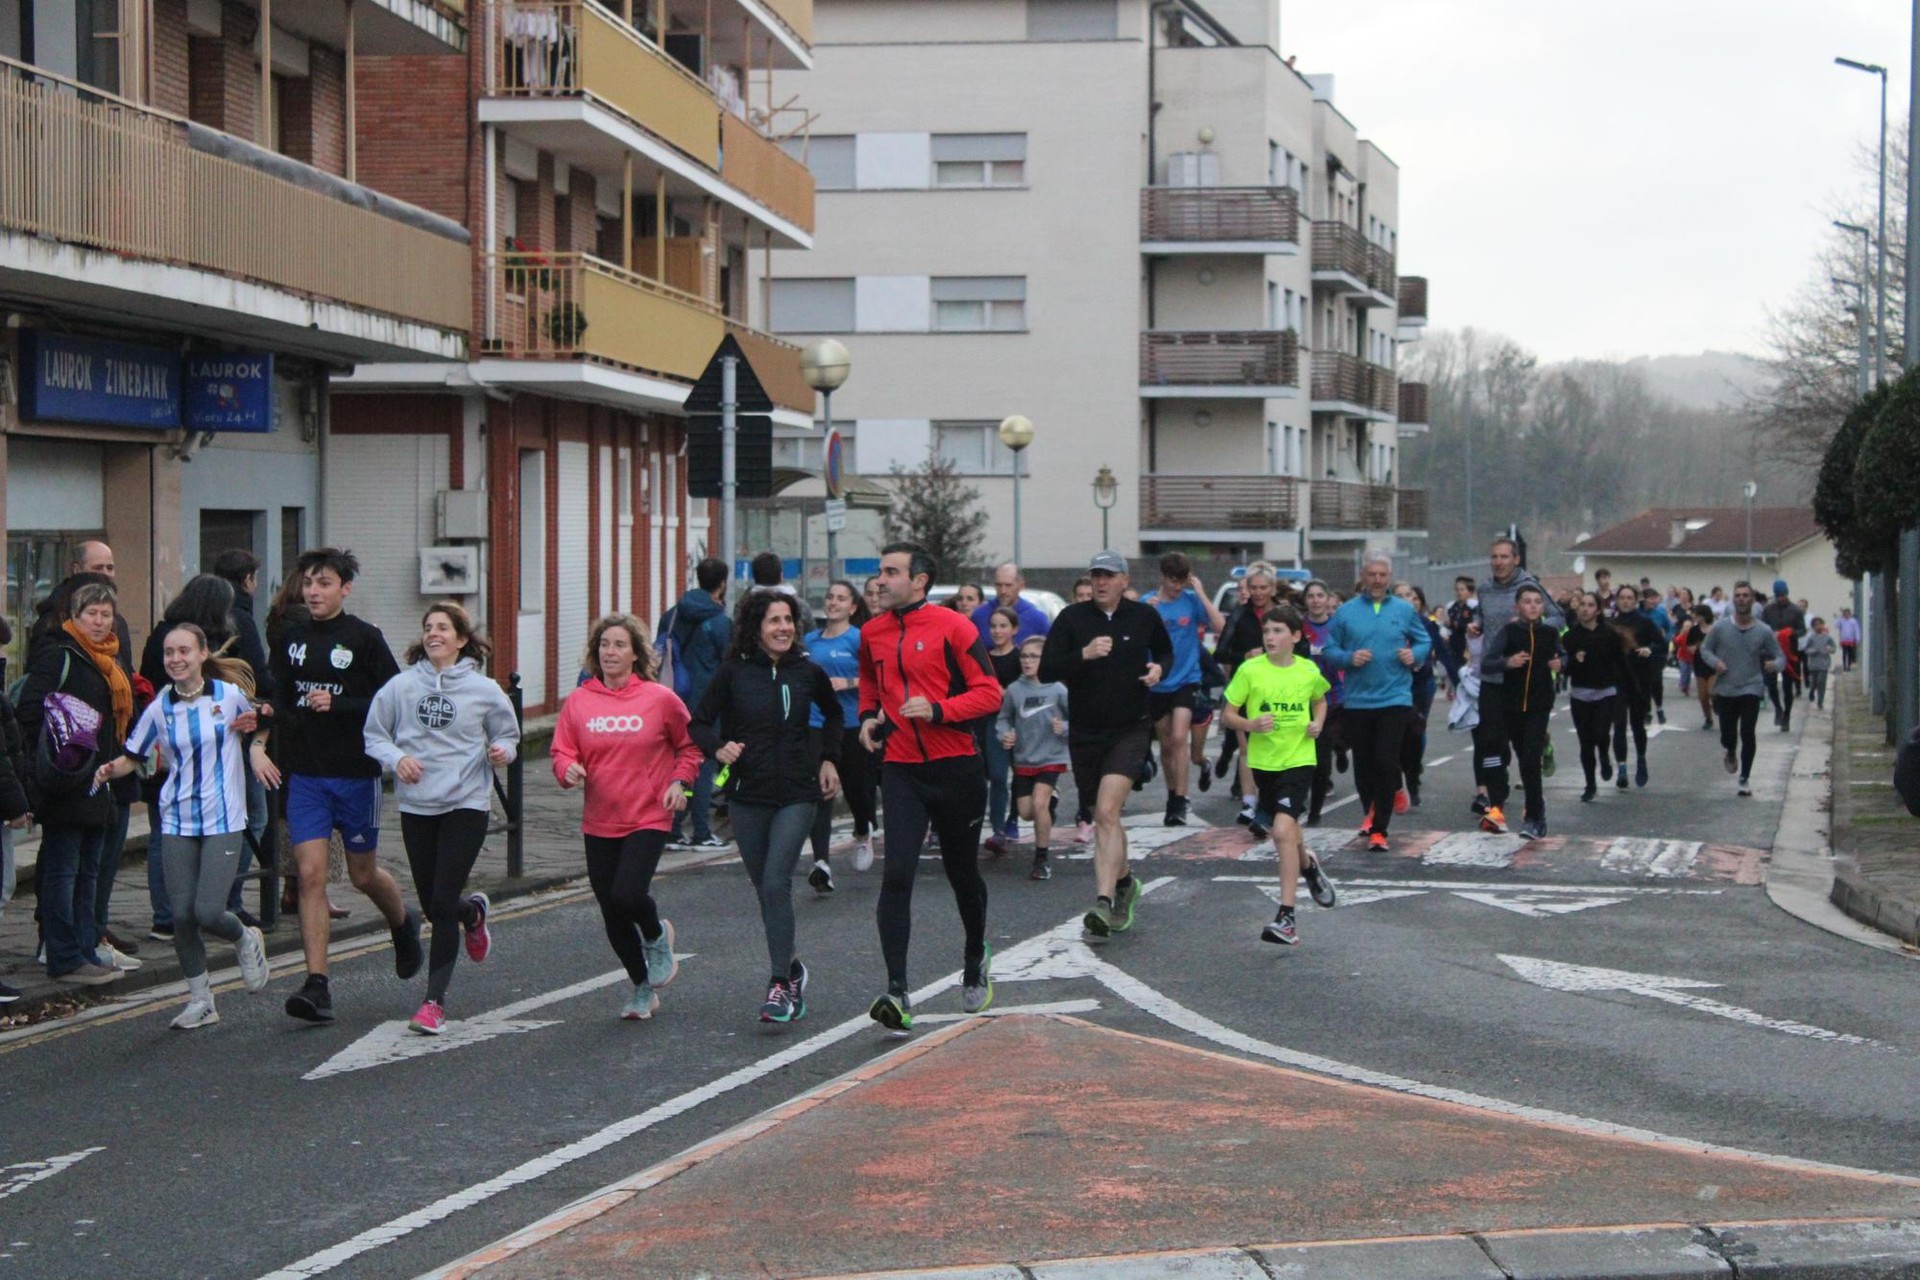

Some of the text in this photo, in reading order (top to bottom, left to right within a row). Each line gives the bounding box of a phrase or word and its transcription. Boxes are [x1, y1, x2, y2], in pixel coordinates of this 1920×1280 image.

[45, 350, 168, 399] LAUROK ZINEBANK
[190, 362, 262, 379] LAUROK
[288, 642, 307, 667] 94
[1273, 702, 1304, 712] TRAIL
[586, 715, 643, 733] +8000
